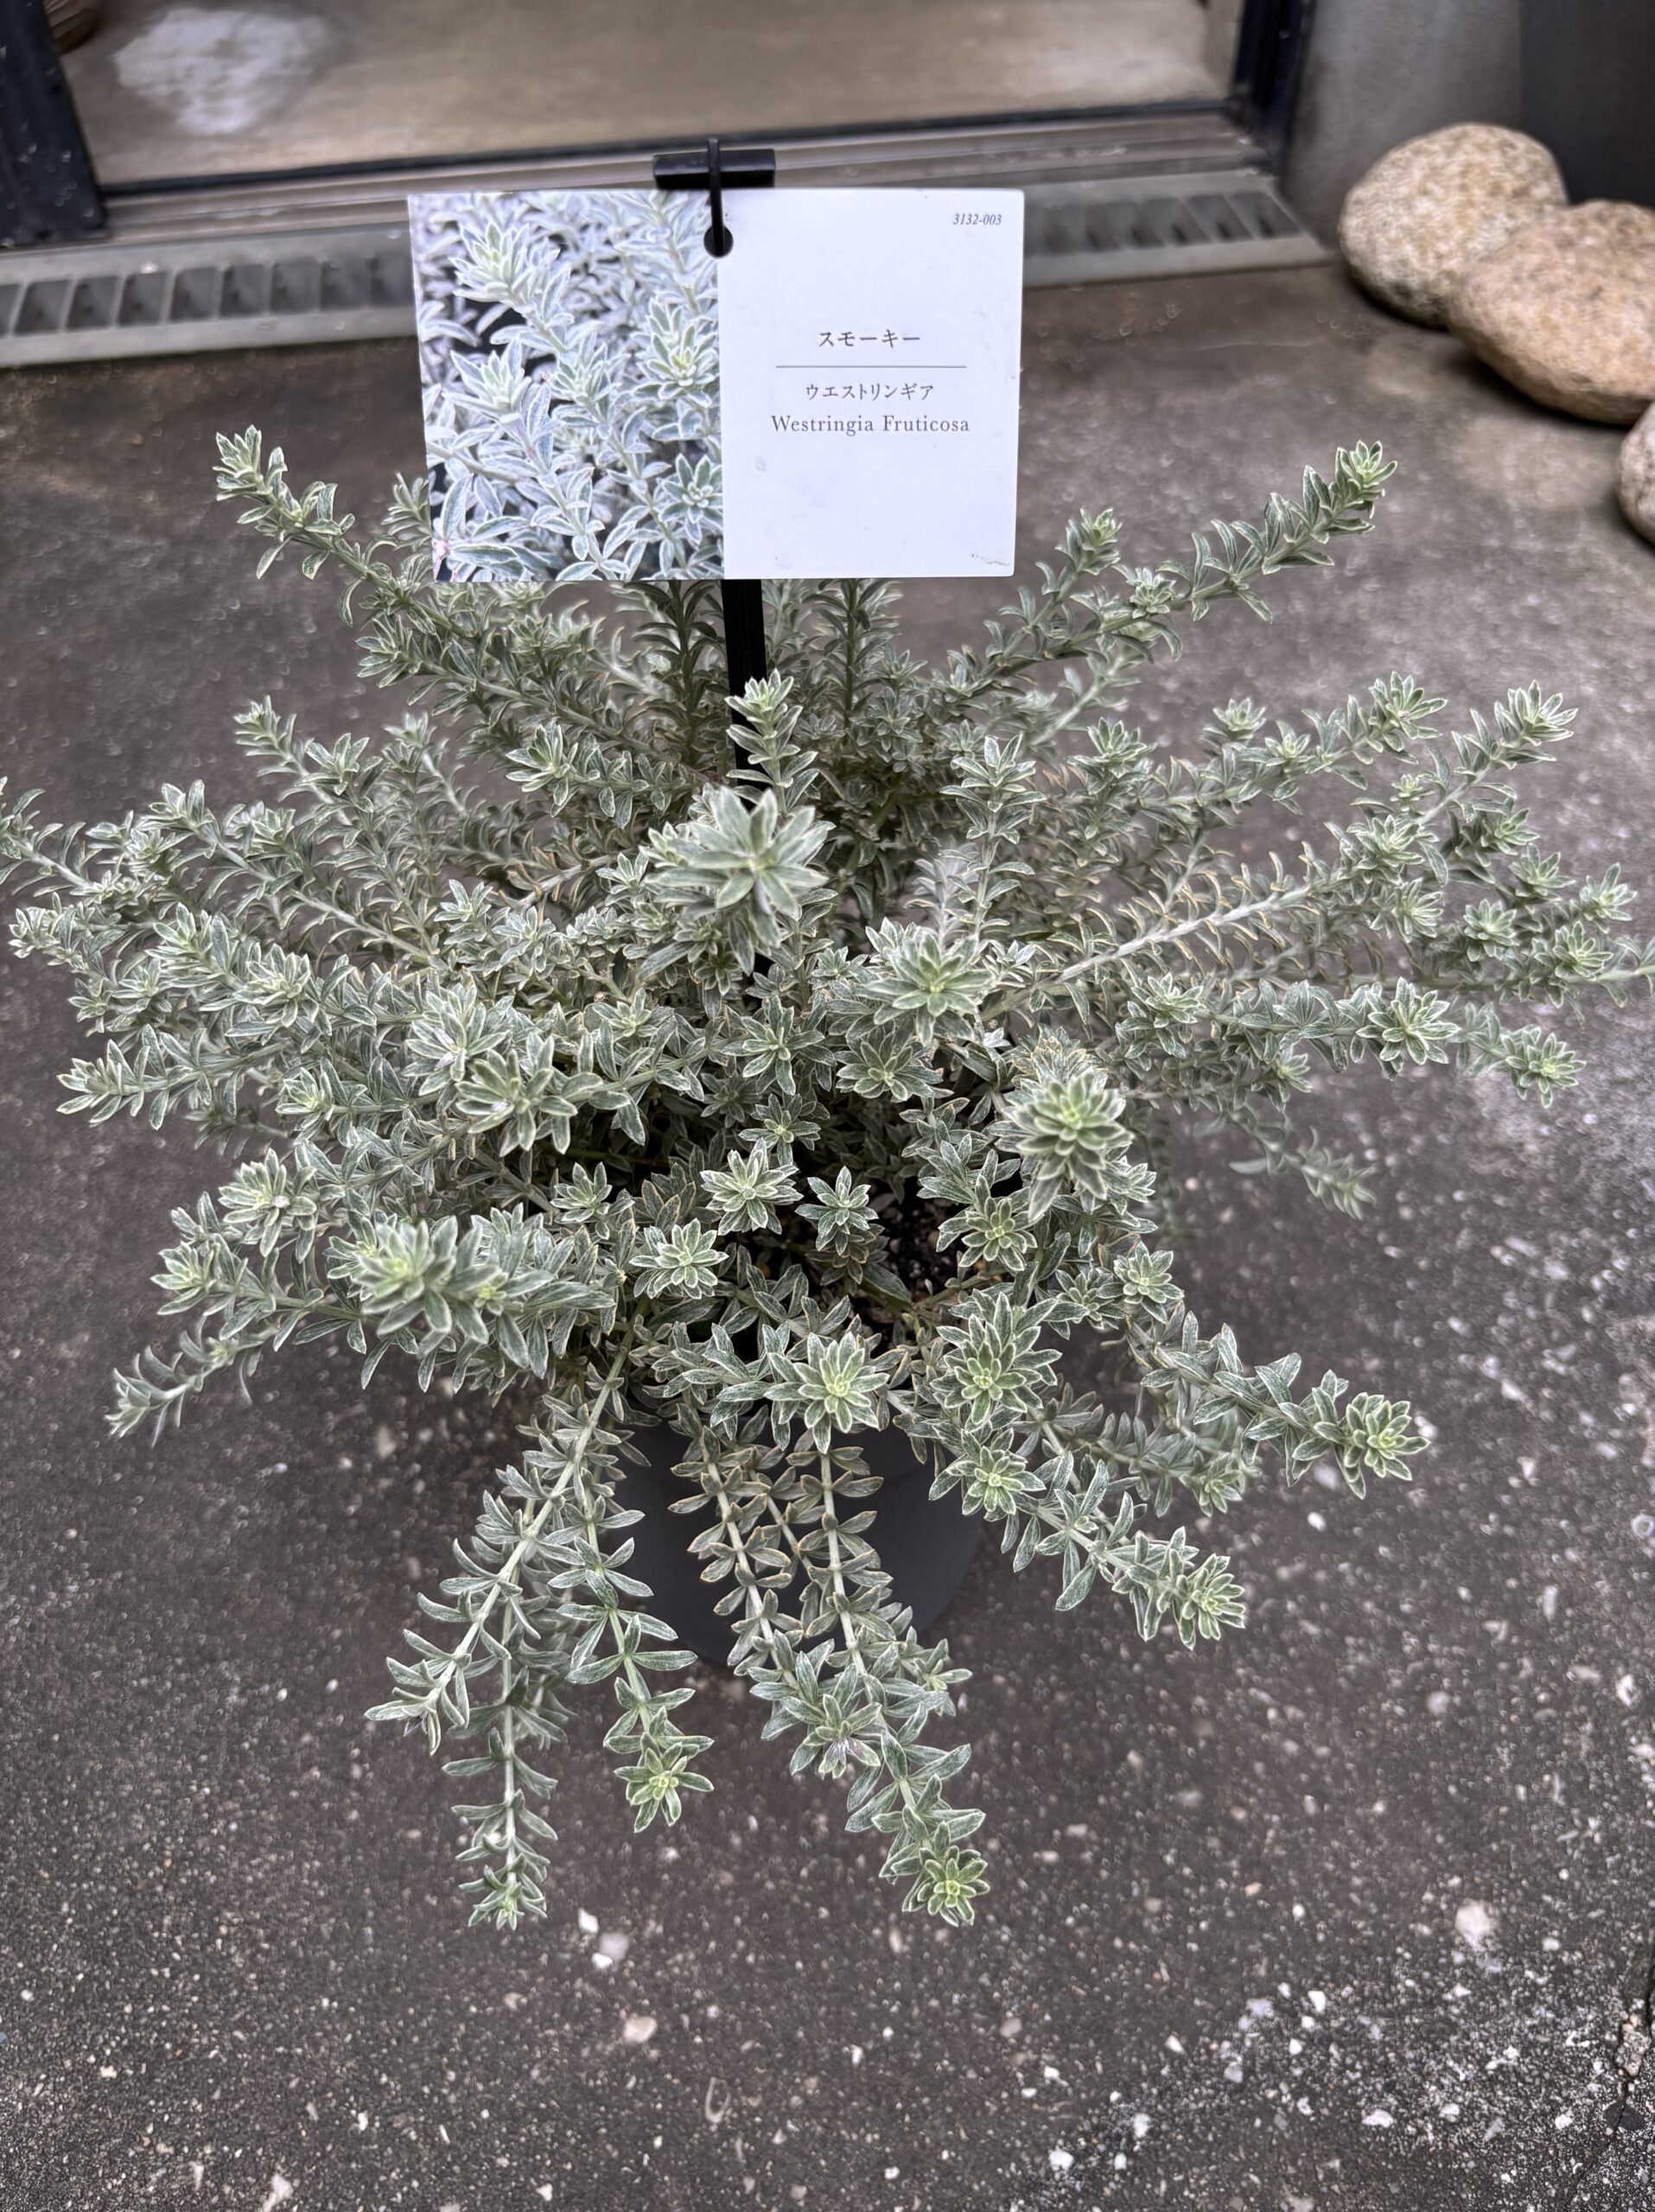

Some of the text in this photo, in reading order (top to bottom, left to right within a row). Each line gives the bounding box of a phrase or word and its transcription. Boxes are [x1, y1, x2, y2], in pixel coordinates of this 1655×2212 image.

[952, 213, 1003, 226] 3132-003
[818, 328, 921, 348] スモーキー
[805, 382, 934, 402] ウエストリンギア
[770, 415, 971, 437] Westringia Fruticosa
